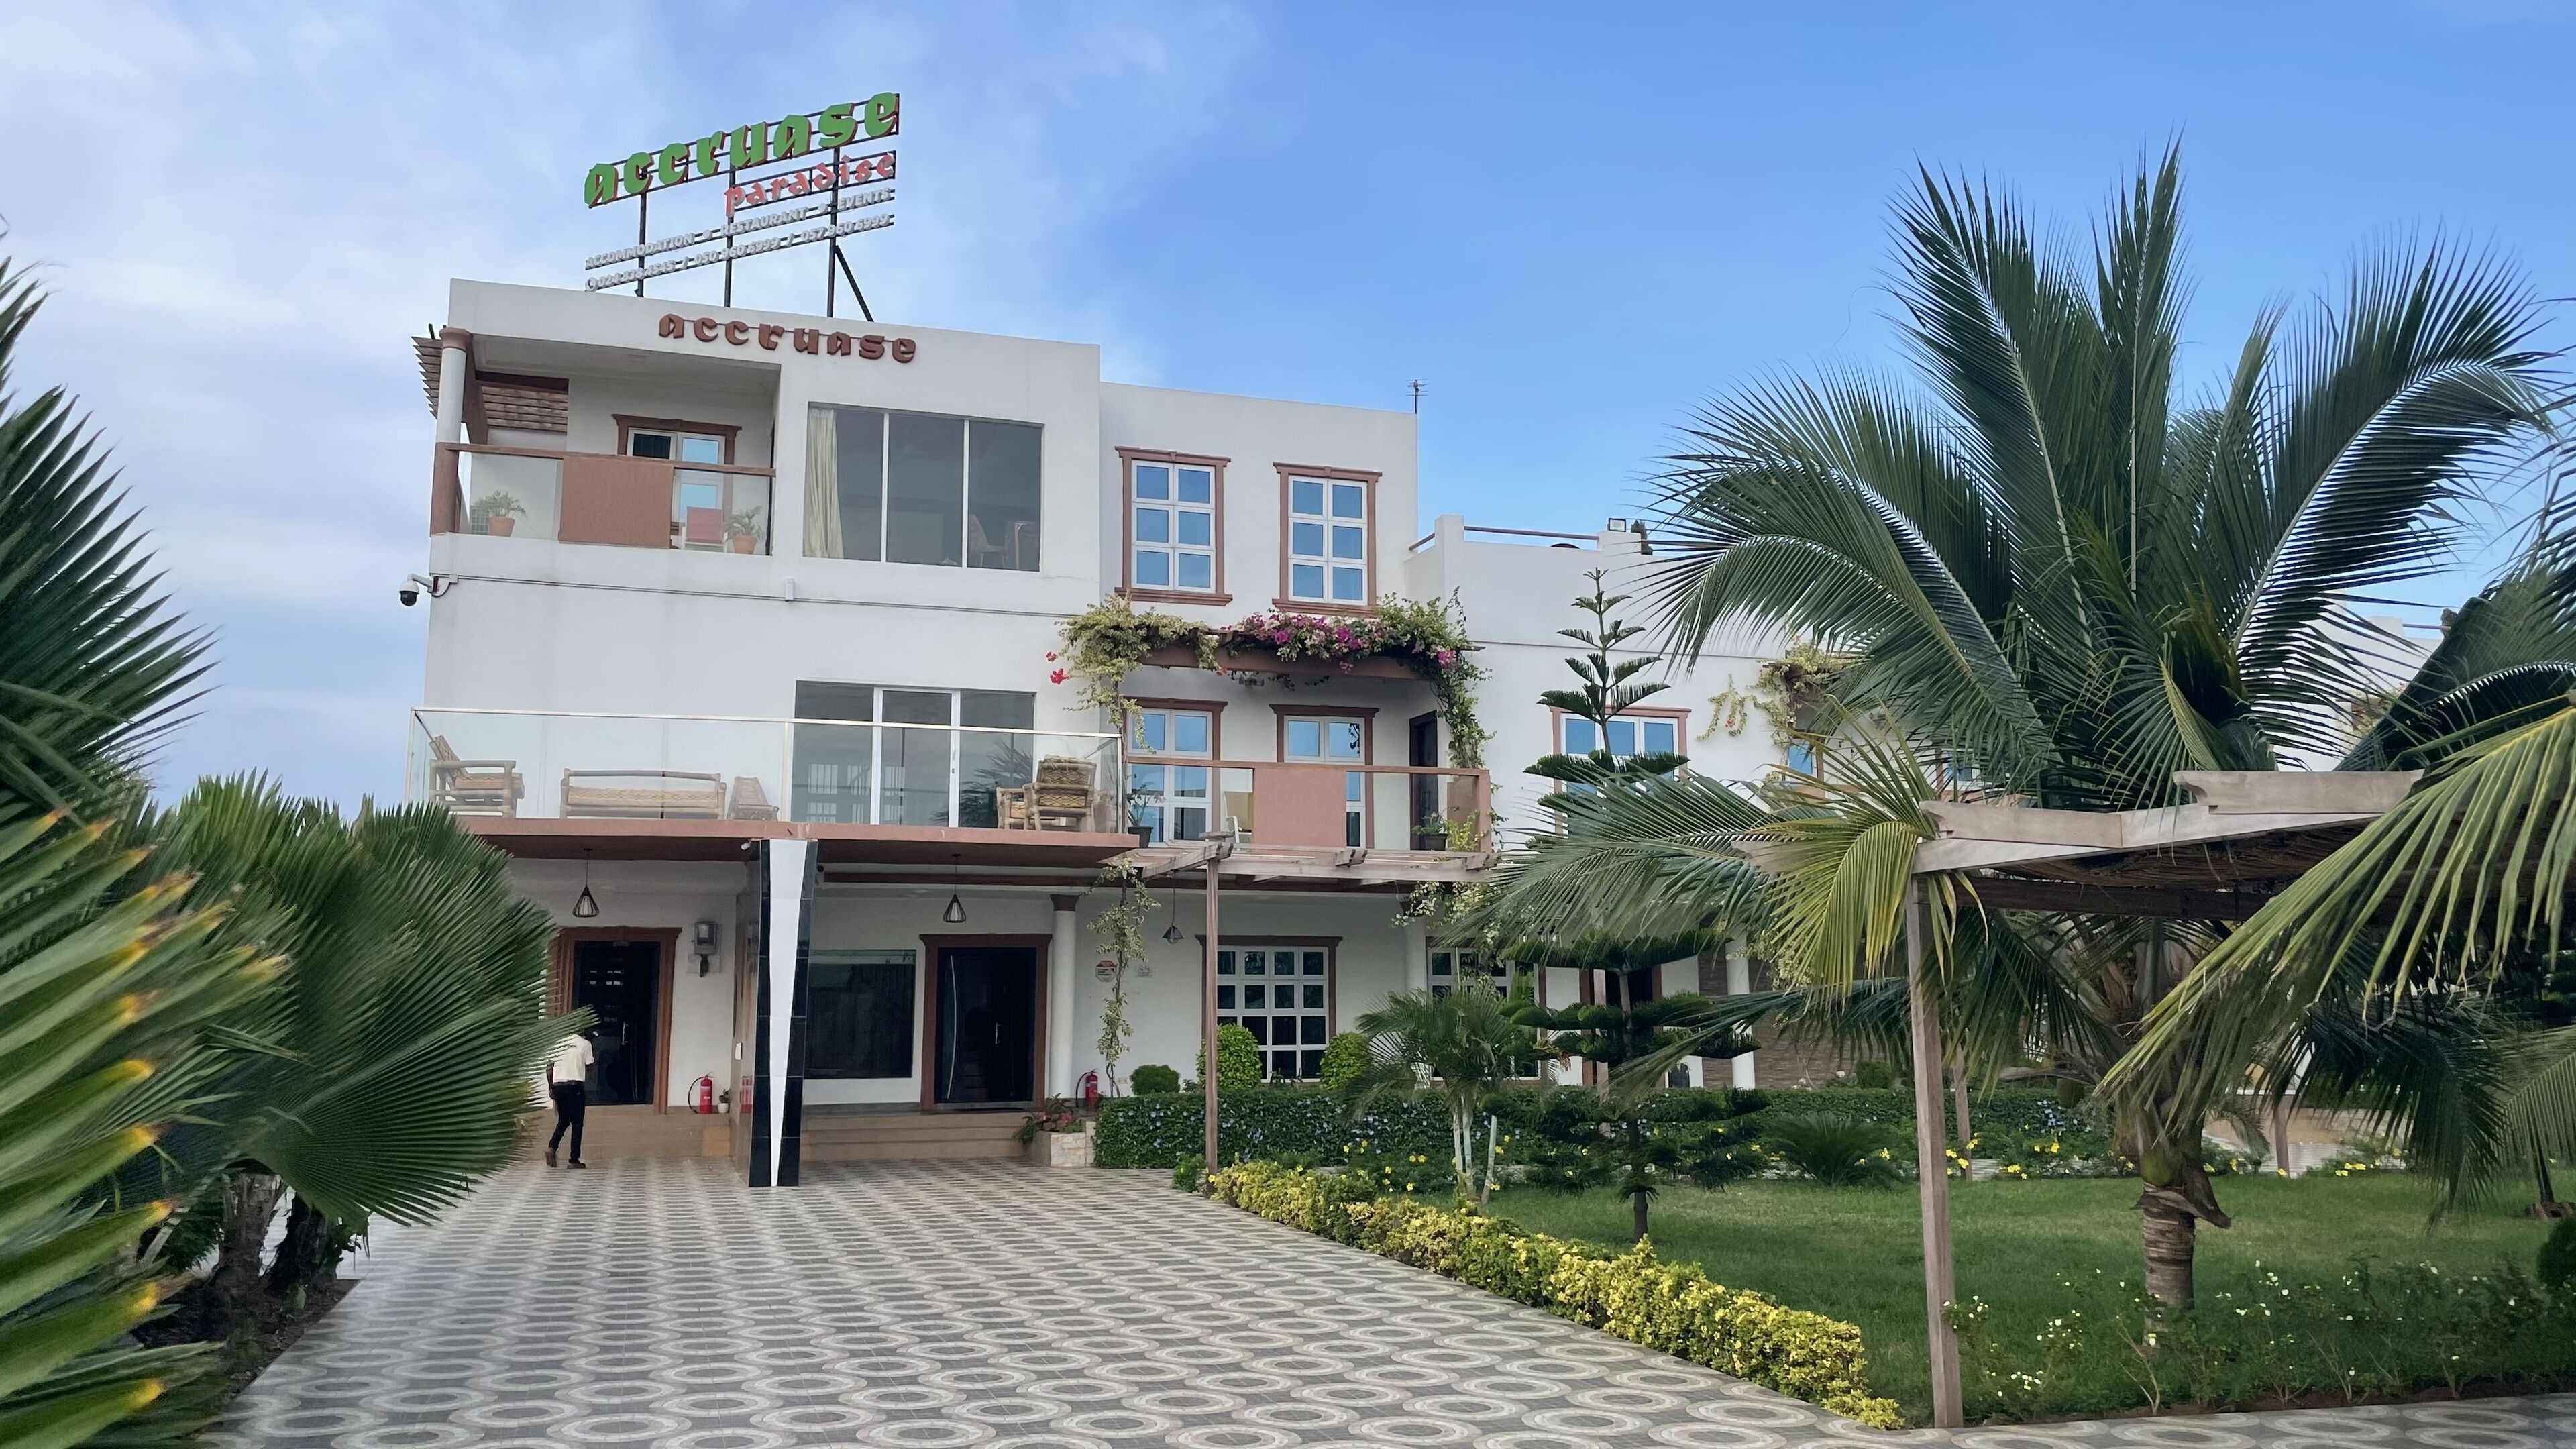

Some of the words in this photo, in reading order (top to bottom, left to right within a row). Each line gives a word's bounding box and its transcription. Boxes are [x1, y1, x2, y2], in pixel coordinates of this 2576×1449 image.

[584, 92, 899, 207] accruase
[585, 233, 695, 270] ACCOMMODATION
[720, 206, 809, 236] RESTAURANT
[838, 188, 891, 211] EVENTS
[659, 313, 916, 364] accruase
